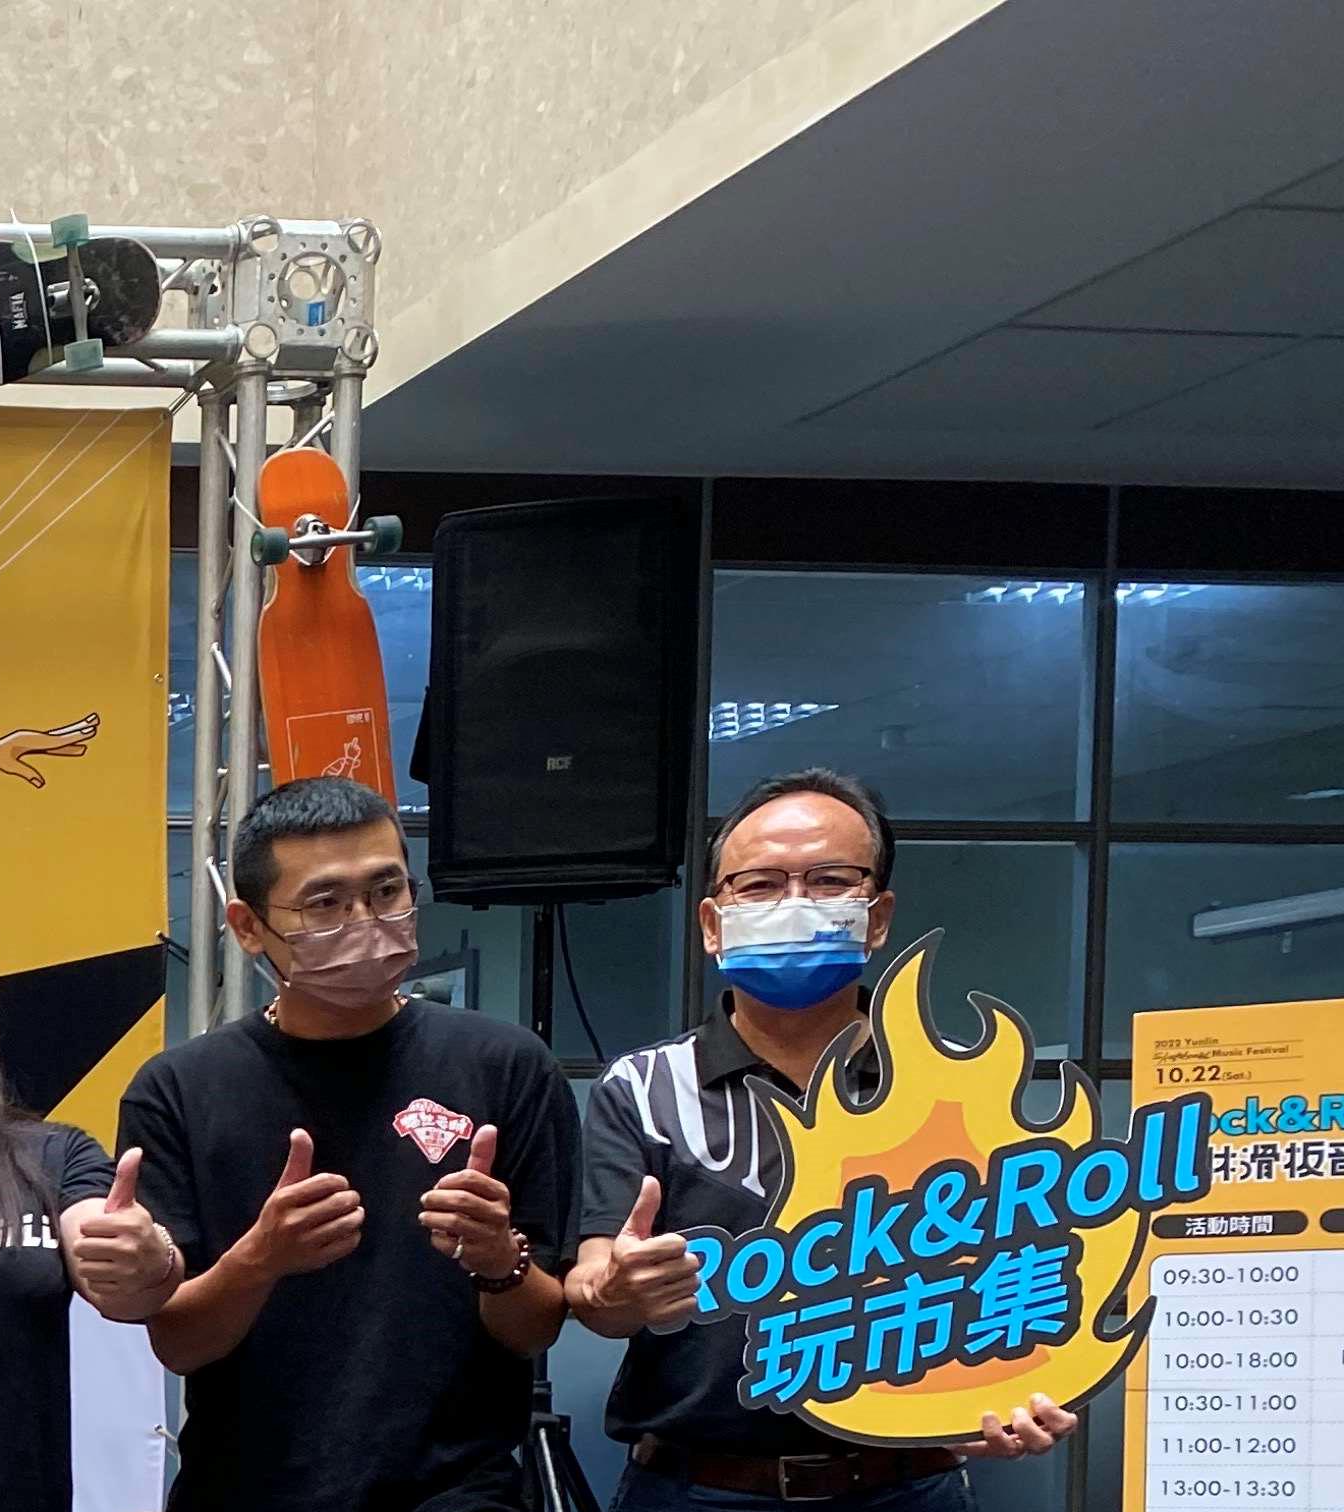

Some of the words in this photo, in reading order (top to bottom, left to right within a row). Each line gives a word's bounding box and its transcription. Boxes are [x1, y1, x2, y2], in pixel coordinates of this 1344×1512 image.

[10, 291, 29, 330] MAFIA
[688, 1101, 1206, 1314] Rock&Roll
[1185, 1213, 1273, 1236] 活動時間
[1163, 1266, 1299, 1285] 09:30-10:00
[749, 1243, 1071, 1405] 玩市集
[1165, 1309, 1298, 1327] 10:00-10:30
[1164, 1351, 1297, 1369] 10:00-18:00
[1163, 1394, 1297, 1411] 10:30-11:00
[1162, 1437, 1296, 1454] 11:00-12:00
[1161, 1480, 1295, 1497] 13:00-13:30
